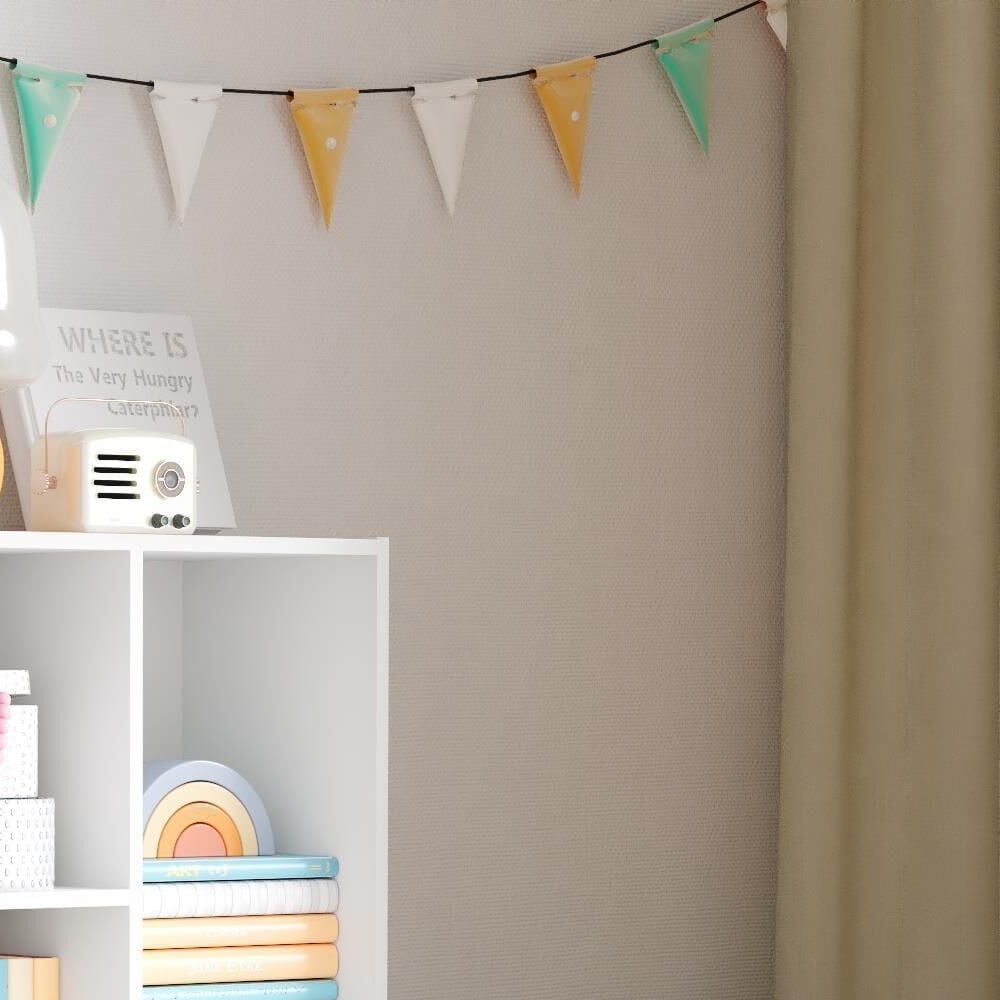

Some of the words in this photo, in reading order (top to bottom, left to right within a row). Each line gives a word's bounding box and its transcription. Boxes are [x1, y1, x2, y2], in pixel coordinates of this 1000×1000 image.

[57, 325, 155, 357] WHERE
[161, 331, 188, 359] IS
[52, 365, 84, 384] The
[89, 366, 127, 389] Very
[132, 368, 193, 393] Hungry
